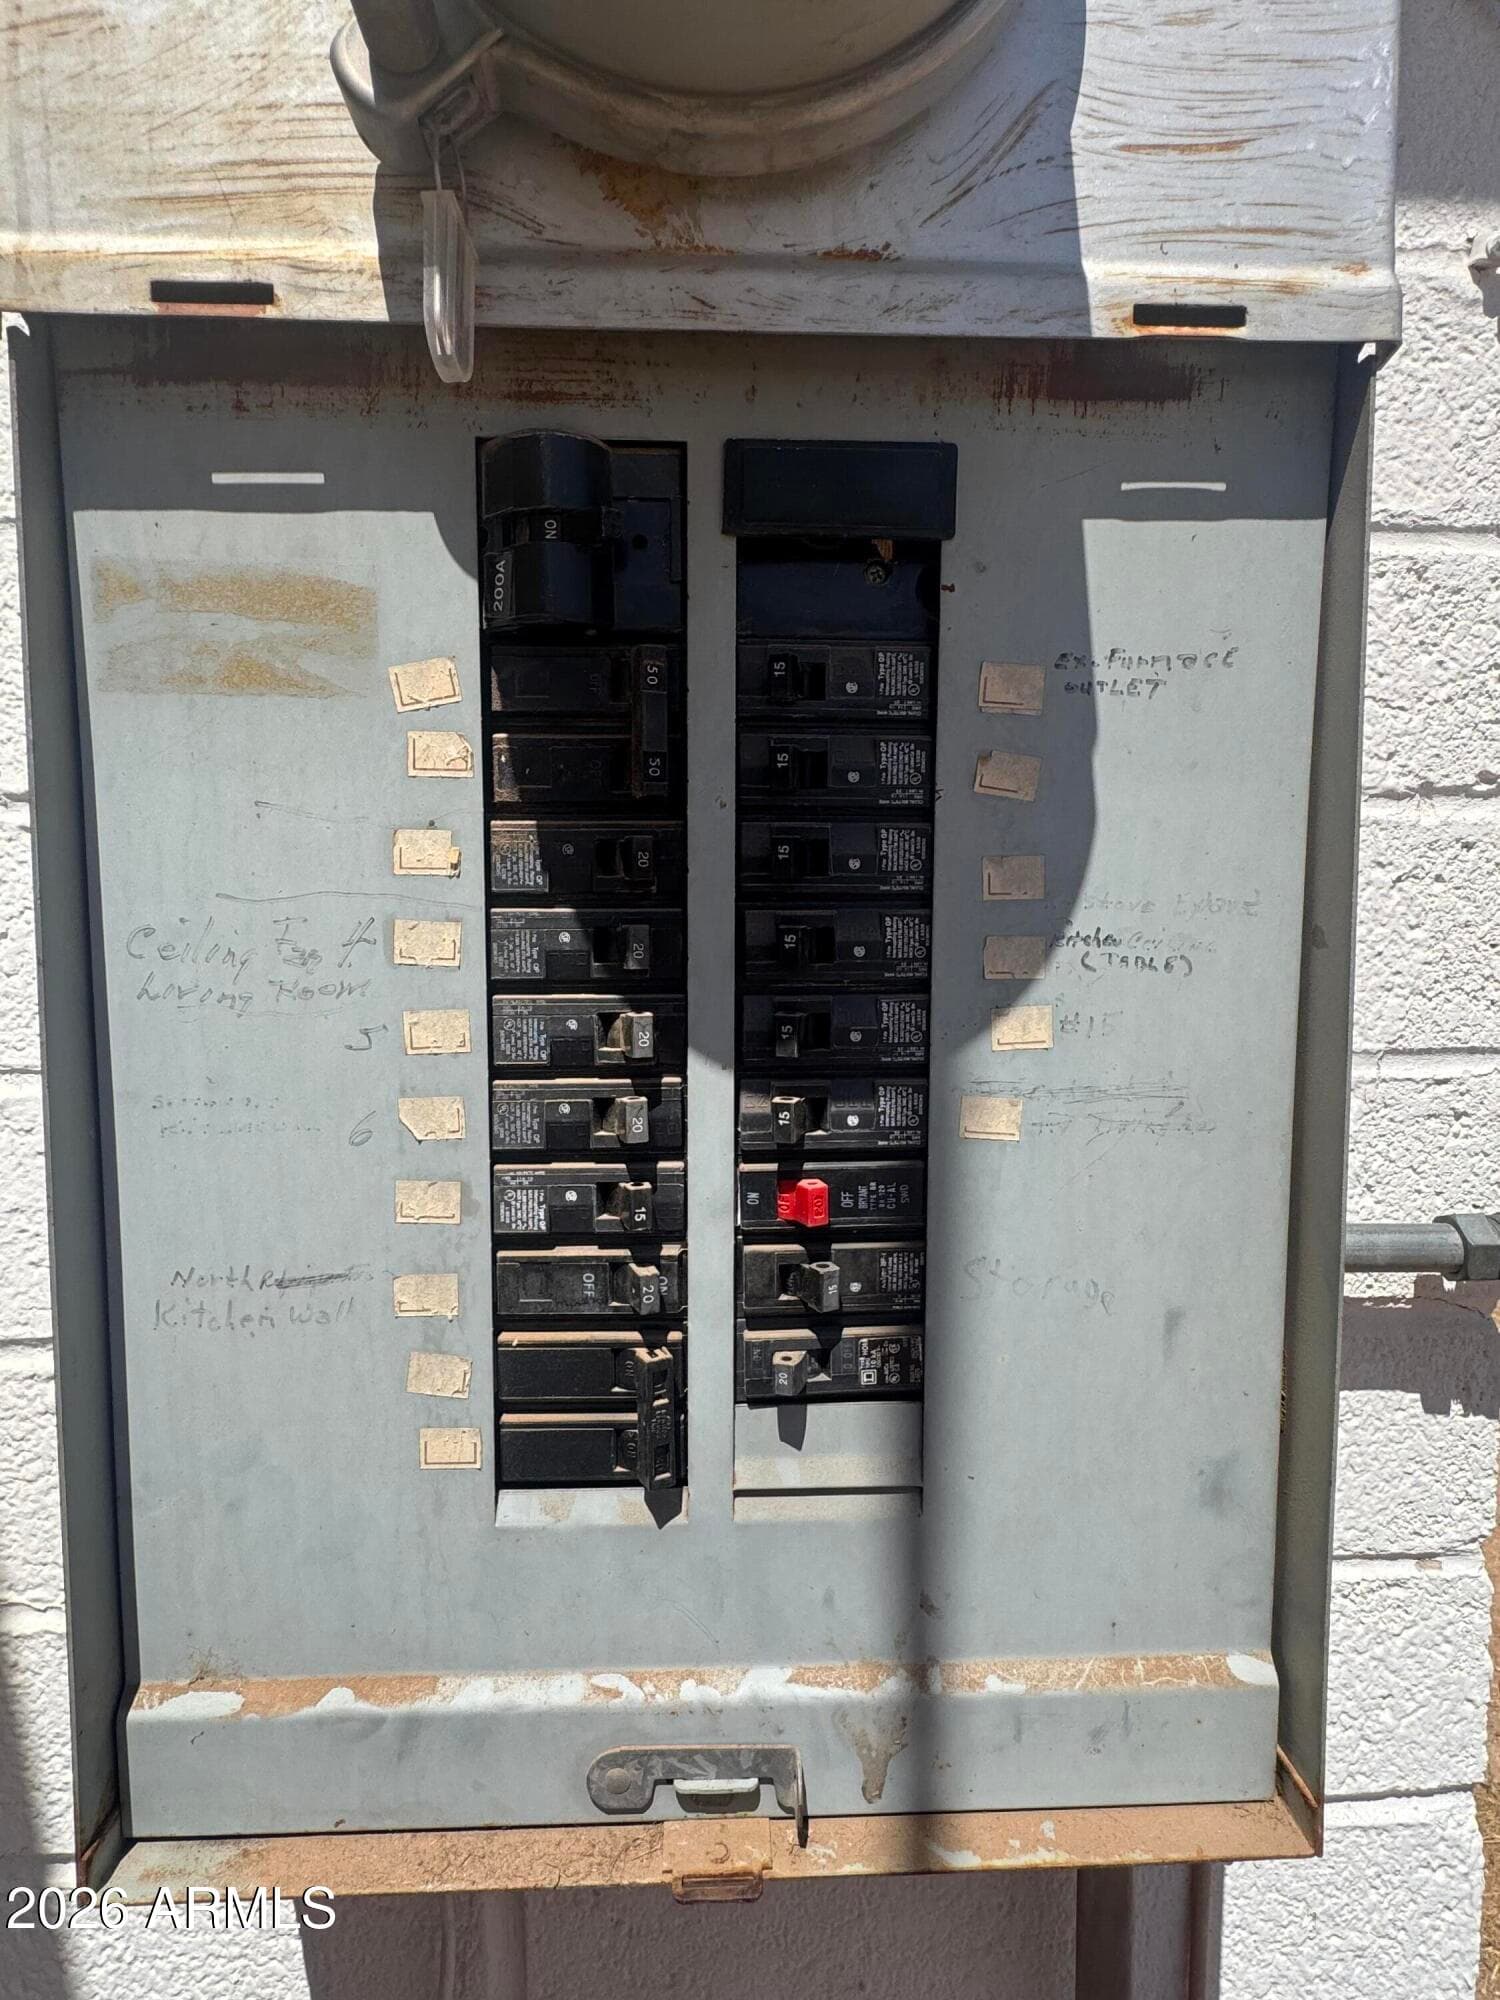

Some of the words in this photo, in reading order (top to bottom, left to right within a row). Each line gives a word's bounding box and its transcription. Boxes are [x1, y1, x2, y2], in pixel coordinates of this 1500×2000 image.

[544, 519, 558, 540] ON
[493, 559, 507, 612] 200A
[646, 663, 658, 685] 50
[774, 661, 786, 677] 15
[648, 757, 661, 777] 50
[777, 752, 789, 768] 15
[637, 851, 649, 868] 20
[777, 844, 790, 861] 15
[784, 934, 796, 949] 15
[632, 943, 644, 959] 20
[638, 1031, 650, 1047] 20
[781, 1024, 793, 1039] 15
[632, 1117, 643, 1133] 20
[778, 1111, 790, 1126] 15
[348, 1110, 377, 1147] 6
[746, 1192, 760, 1205] ON
[841, 1191, 854, 1208] OFF
[634, 1206, 647, 1222] 15
[582, 1273, 595, 1297] OFF
[828, 1283, 838, 1294] 15
[642, 1284, 655, 1304] 20
[778, 1372, 788, 1386] 20
